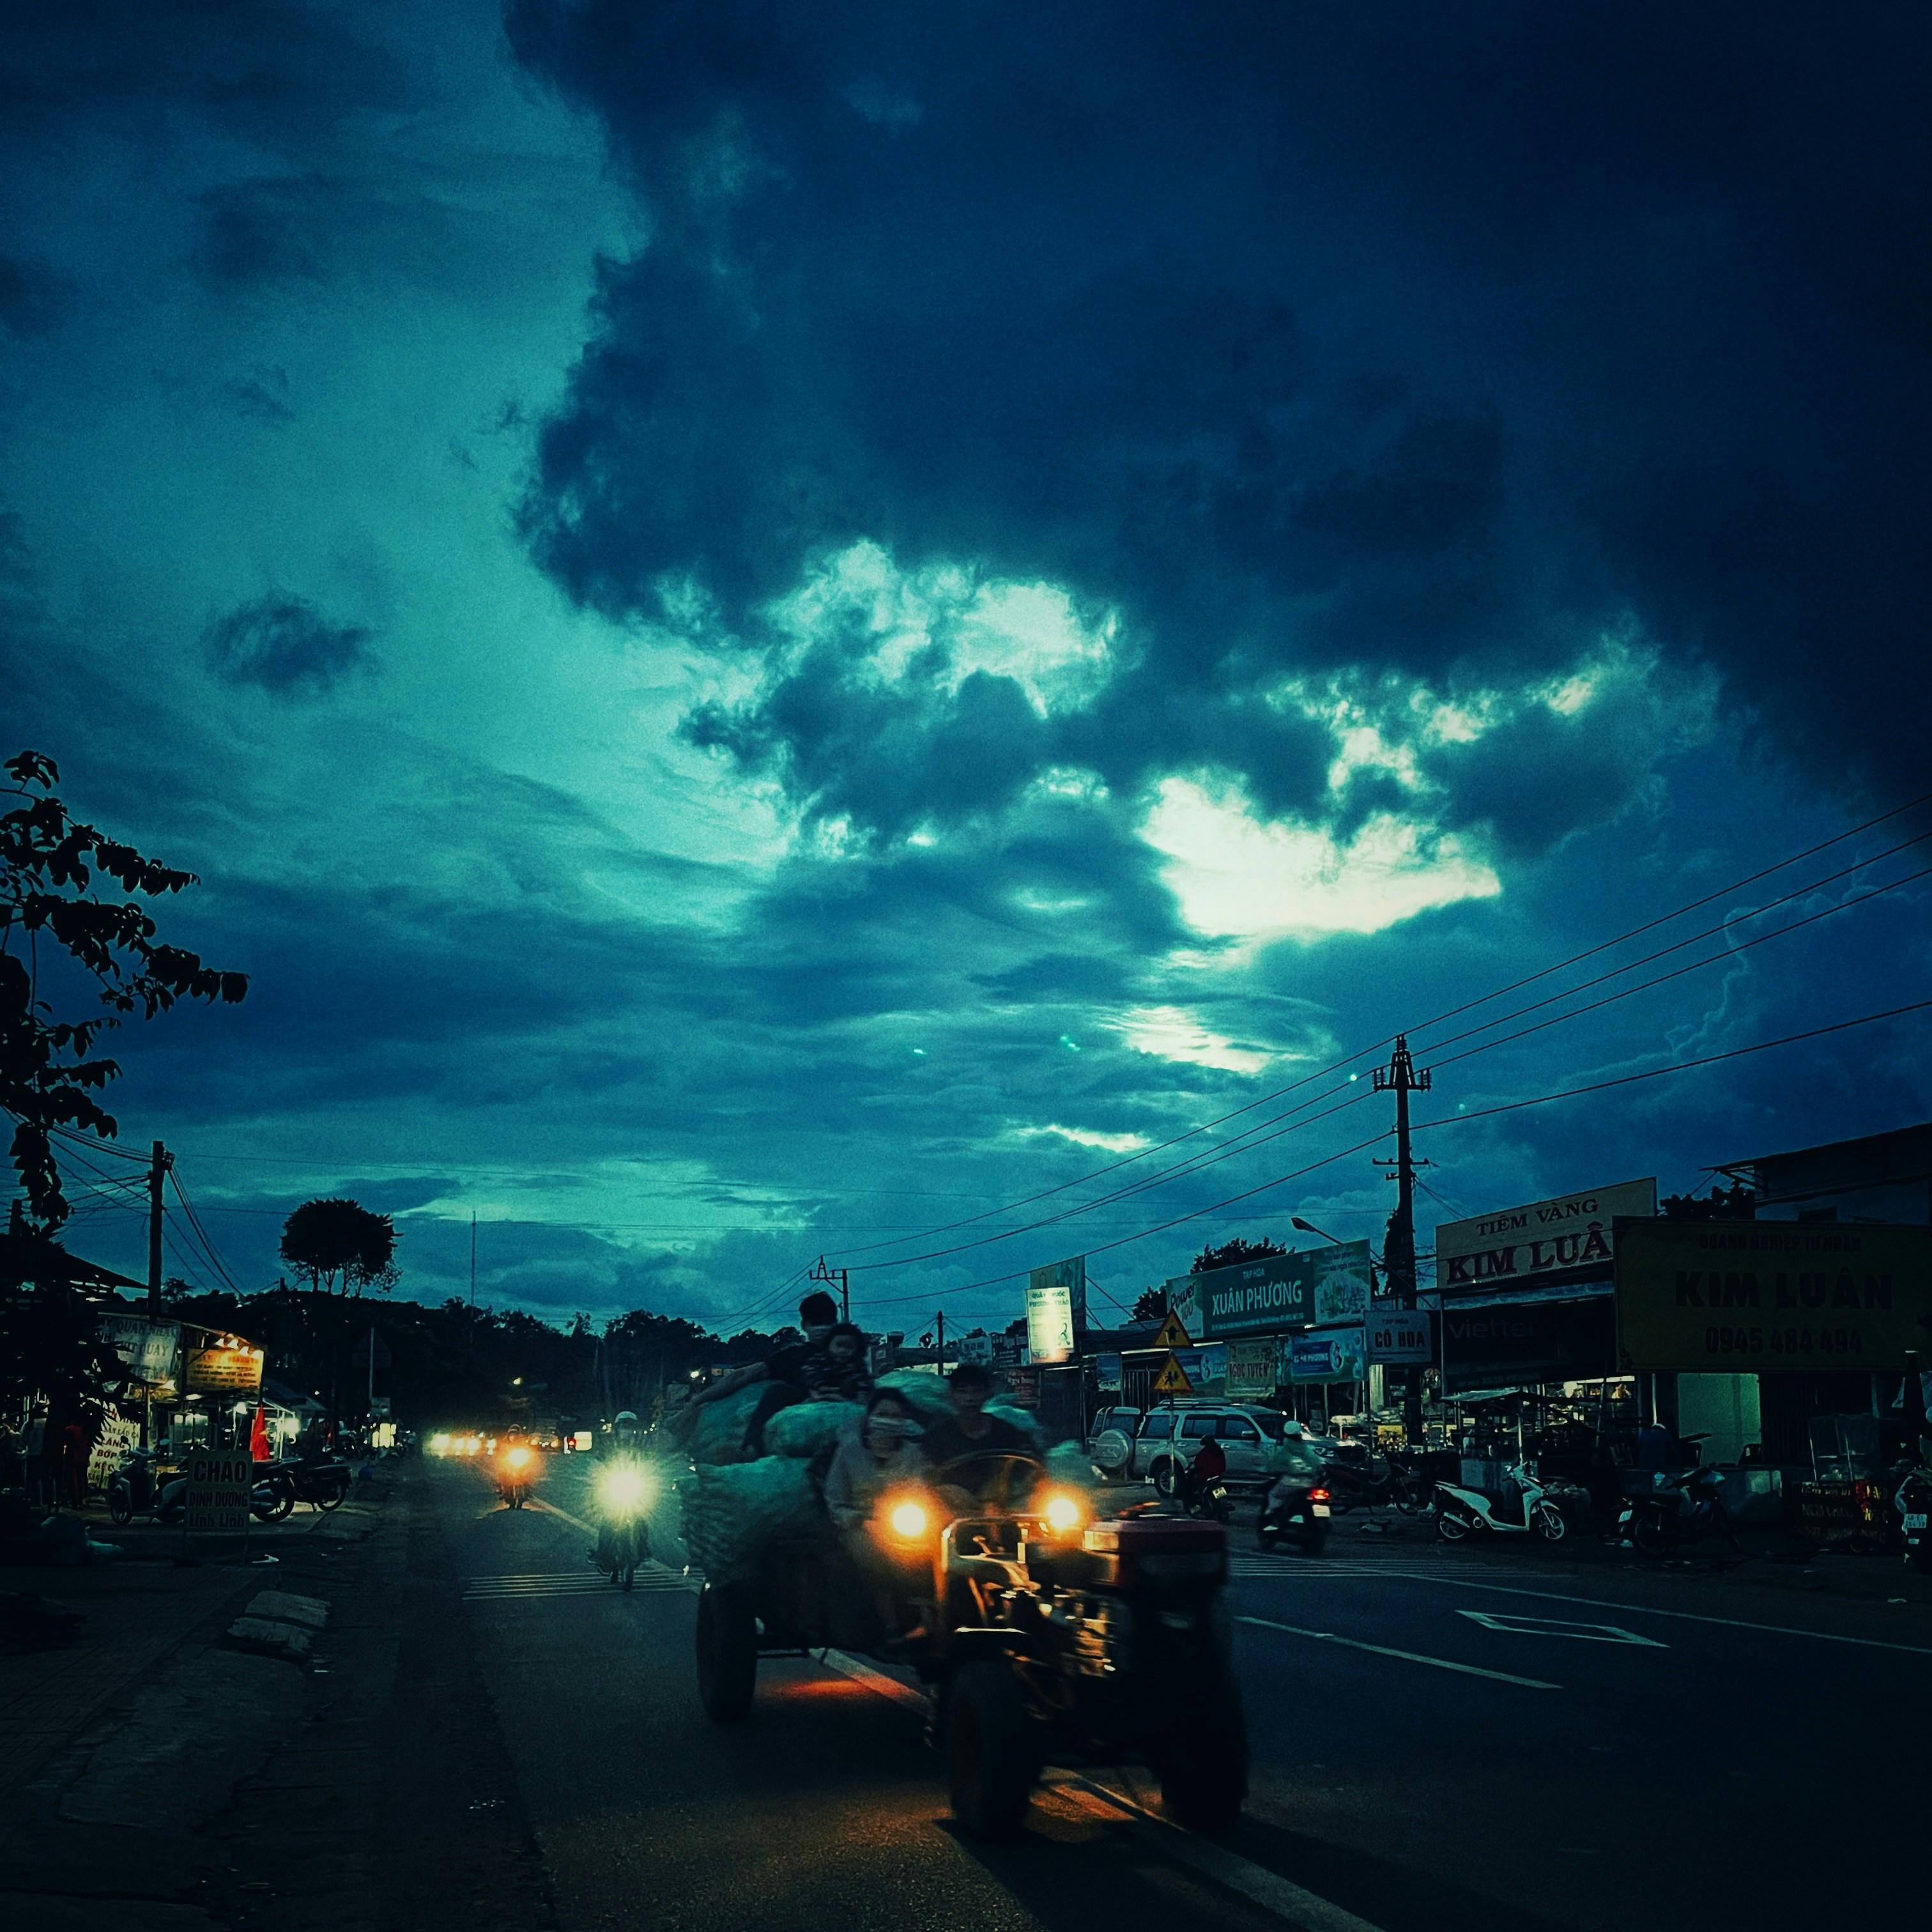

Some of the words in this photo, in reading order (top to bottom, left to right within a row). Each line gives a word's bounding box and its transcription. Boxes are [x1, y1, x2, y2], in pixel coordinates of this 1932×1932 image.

[1476, 1214, 1528, 1238] TIỆM
[1536, 1199, 1598, 1223] VÀNG
[1446, 1247, 1517, 1285] KIM
[1529, 1221, 1613, 1271] LUÂ
[1699, 1233, 1747, 1250] DOANH
[1170, 1280, 1197, 1309] Power
[1211, 1286, 1244, 1316] XUÂN
[1246, 1280, 1303, 1311] PHƯƠNG
[1675, 1271, 1761, 1307] KIM
[1775, 1266, 1892, 1309] LUÂN
[1375, 1329, 1392, 1348] CÔ
[1398, 1331, 1425, 1347] HOA
[1448, 1318, 1537, 1339] viettel
[1705, 1326, 1762, 1354] 0945
[1770, 1328, 1813, 1354] 484
[1820, 1328, 1862, 1354] 494
[194, 1455, 247, 1483] CHÁO
[189, 1512, 215, 1528] Linh
[218, 1512, 245, 1528] Linh
